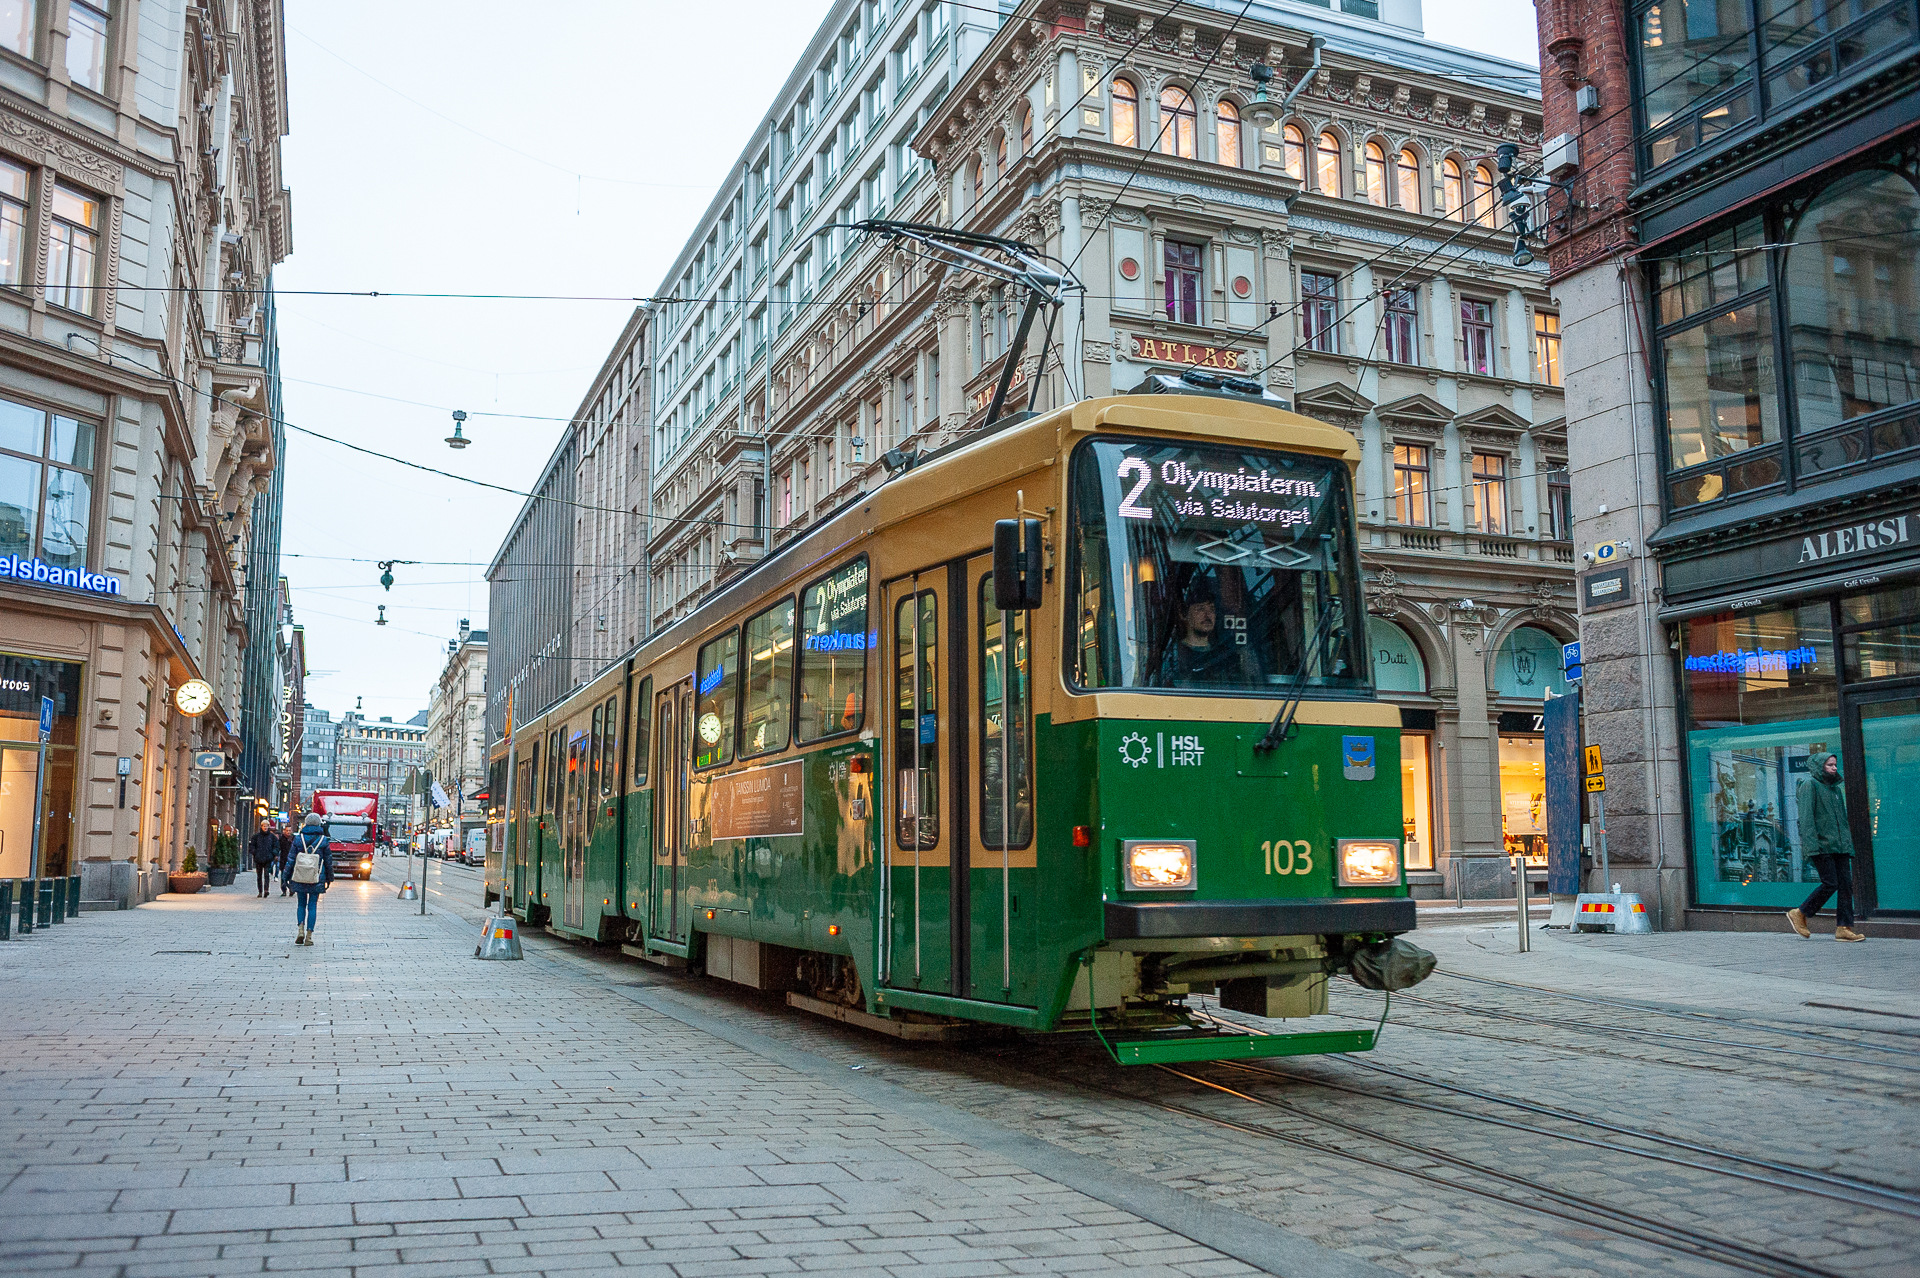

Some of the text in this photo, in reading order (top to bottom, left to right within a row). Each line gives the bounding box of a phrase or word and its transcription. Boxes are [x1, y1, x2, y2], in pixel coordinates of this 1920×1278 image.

[1140, 338, 1238, 370] ATLAS
[976, 364, 1021, 411] ATS
[1117, 457, 1153, 519] 2
[1161, 460, 1320, 498] Olympiaterm.
[1175, 497, 1312, 528] via Salutorget
[1798, 515, 1909, 564] ALEKSI
[0, 553, 121, 595] elsbanken
[1844, 580, 1859, 588] Café
[817, 586, 827, 634] 2
[1731, 602, 1745, 610] Café
[1378, 649, 1408, 665] Dutti
[0, 677, 30, 692] roos
[1171, 735, 1205, 751] HSL
[1171, 751, 1205, 766] HRT
[1261, 839, 1313, 875] 103
